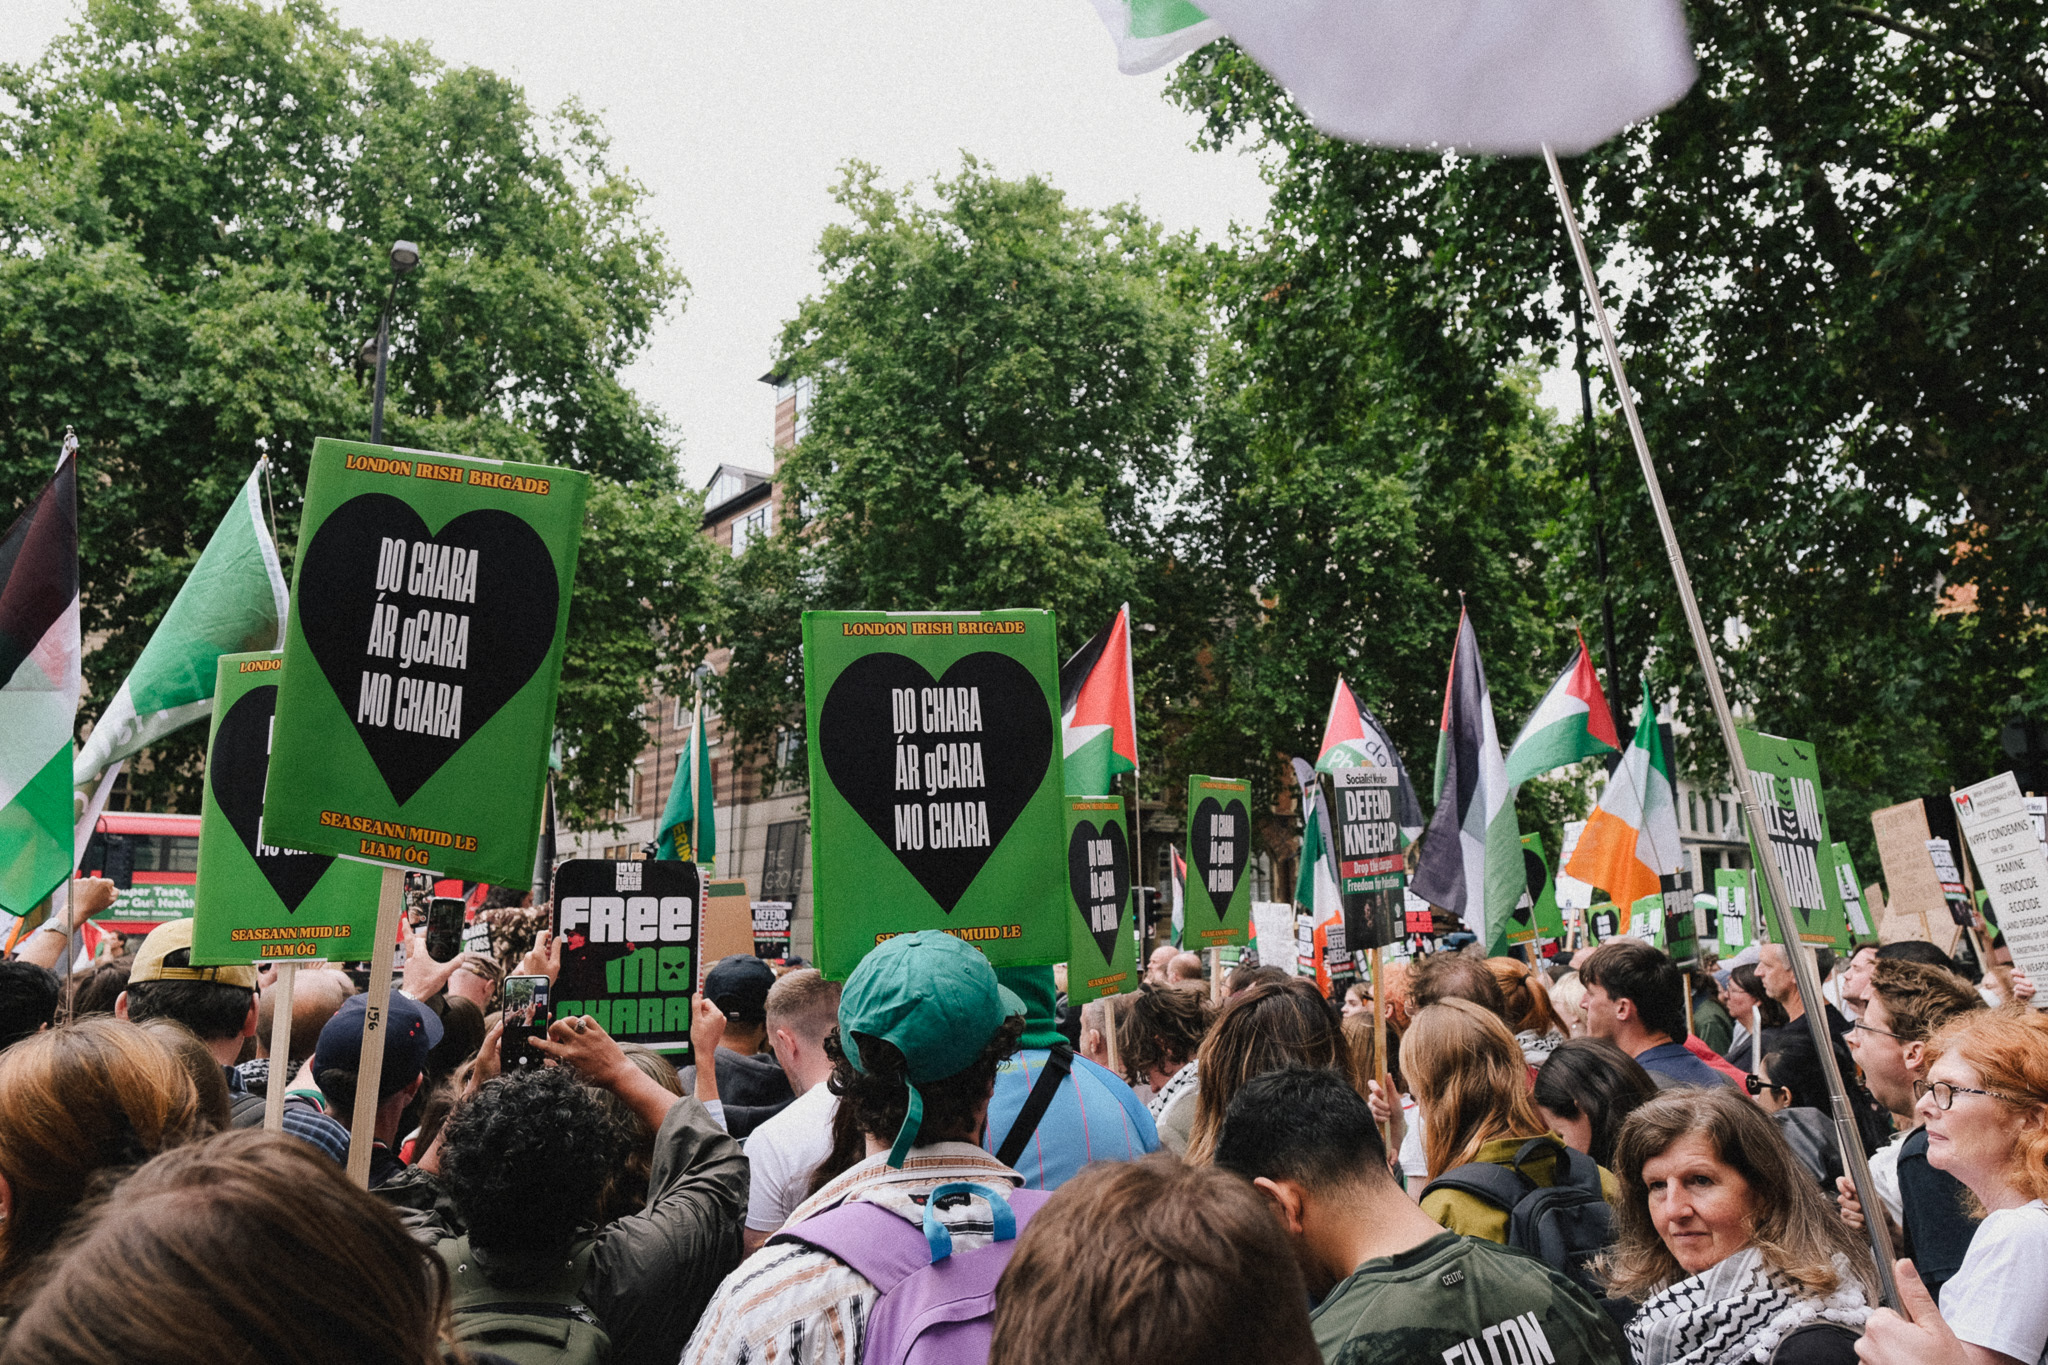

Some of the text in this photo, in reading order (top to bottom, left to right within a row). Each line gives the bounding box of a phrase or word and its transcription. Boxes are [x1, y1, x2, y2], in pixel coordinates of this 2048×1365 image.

[345, 454, 550, 496] LONDON IRISH BRIGADE
[375, 537, 479, 604] DO CHARA
[366, 592, 470, 670] ÁR gCARA
[842, 621, 1026, 636] LONDON IRISH BRIGADE
[239, 658, 282, 673] LONDO
[357, 671, 463, 740] MO CHARA
[892, 686, 983, 734] DO CHARA
[895, 735, 986, 797] ÁR gCARA
[1344, 789, 1391, 821] DEFEND
[1790, 776, 1823, 842] MO
[319, 810, 407, 840] SEASEANN
[407, 827, 453, 848] MUID
[453, 834, 478, 852] LE
[894, 801, 991, 851] MO CHARA
[1987, 819, 2029, 841] CONDEMNS
[1343, 821, 1397, 856] KNEECAP
[359, 839, 430, 865] LIAM ÓG
[764, 869, 802, 890] GROE
[1353, 862, 1369, 876] Drop
[118, 888, 151, 898] uper
[1347, 879, 1374, 892] Freedom
[108, 899, 130, 909] per
[755, 910, 787, 920] DEFEND
[230, 924, 352, 942] SEASEANN MUID LE
[752, 920, 790, 931] KNEECAP
[959, 926, 1001, 941] MUID
[1001, 924, 1022, 940] LE
[261, 941, 317, 958] LIAM ÓG
[367, 1006, 380, 1031] 156
[1442, 1270, 1464, 1286] CELTIC
